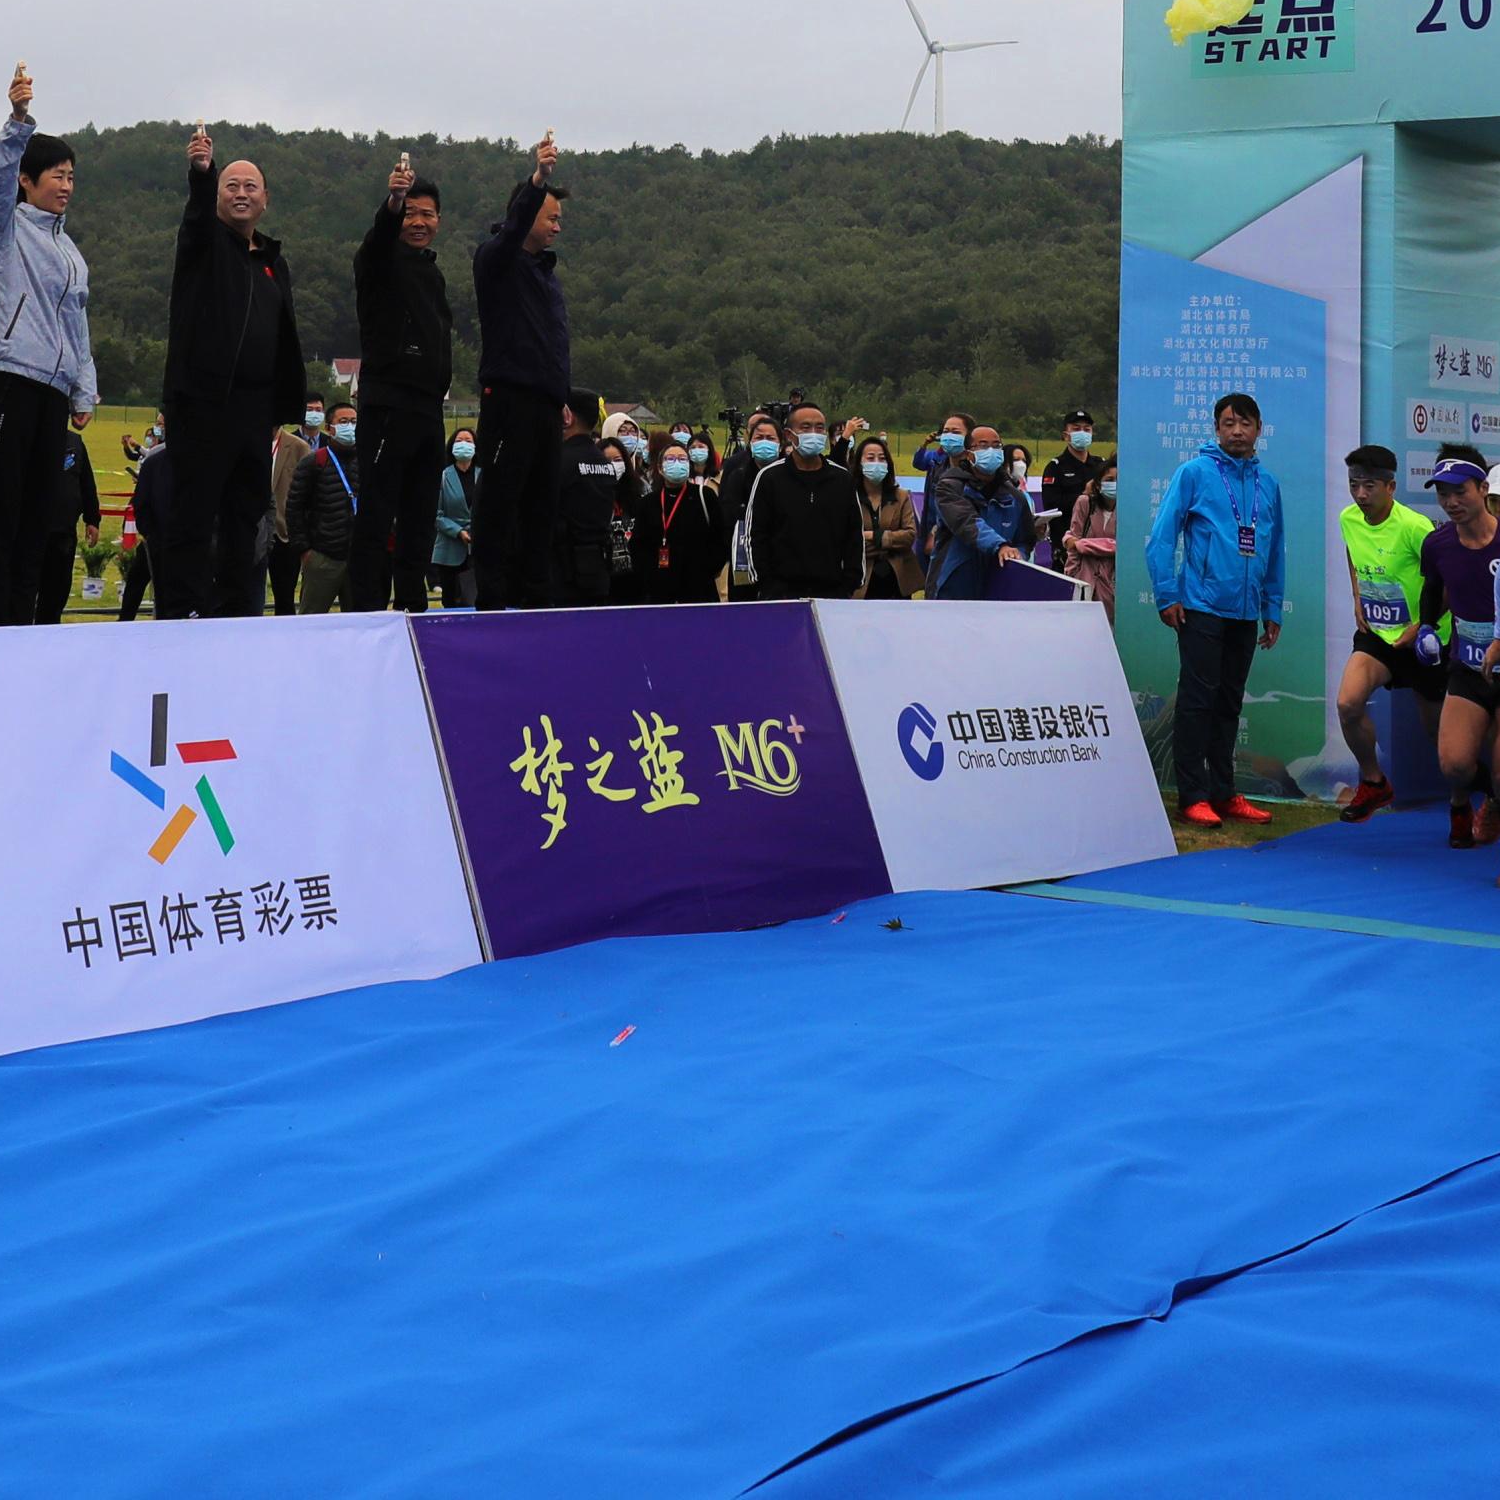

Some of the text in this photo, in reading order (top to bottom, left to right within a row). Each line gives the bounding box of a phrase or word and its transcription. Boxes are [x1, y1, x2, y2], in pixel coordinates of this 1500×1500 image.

[1204, 35, 1336, 64] START
[1180, 309, 1251, 321] 湖北省体育局
[1180, 323, 1251, 335] 湖北省商务厅
[1163, 337, 1269, 349] 湖北省文化和旅游厅
[1179, 352, 1251, 363] 湖北省总工会
[1435, 344, 1471, 380] 梦之蓝
[1173, 380, 1257, 392] 湖北省体育总会
[1363, 602, 1401, 622] 1097
[947, 704, 1110, 744] 中国建设银行
[958, 743, 1101, 770] China Construction Bank
[509, 708, 701, 851] 梦之蓝
[61, 872, 339, 969] 中国体育彩票
